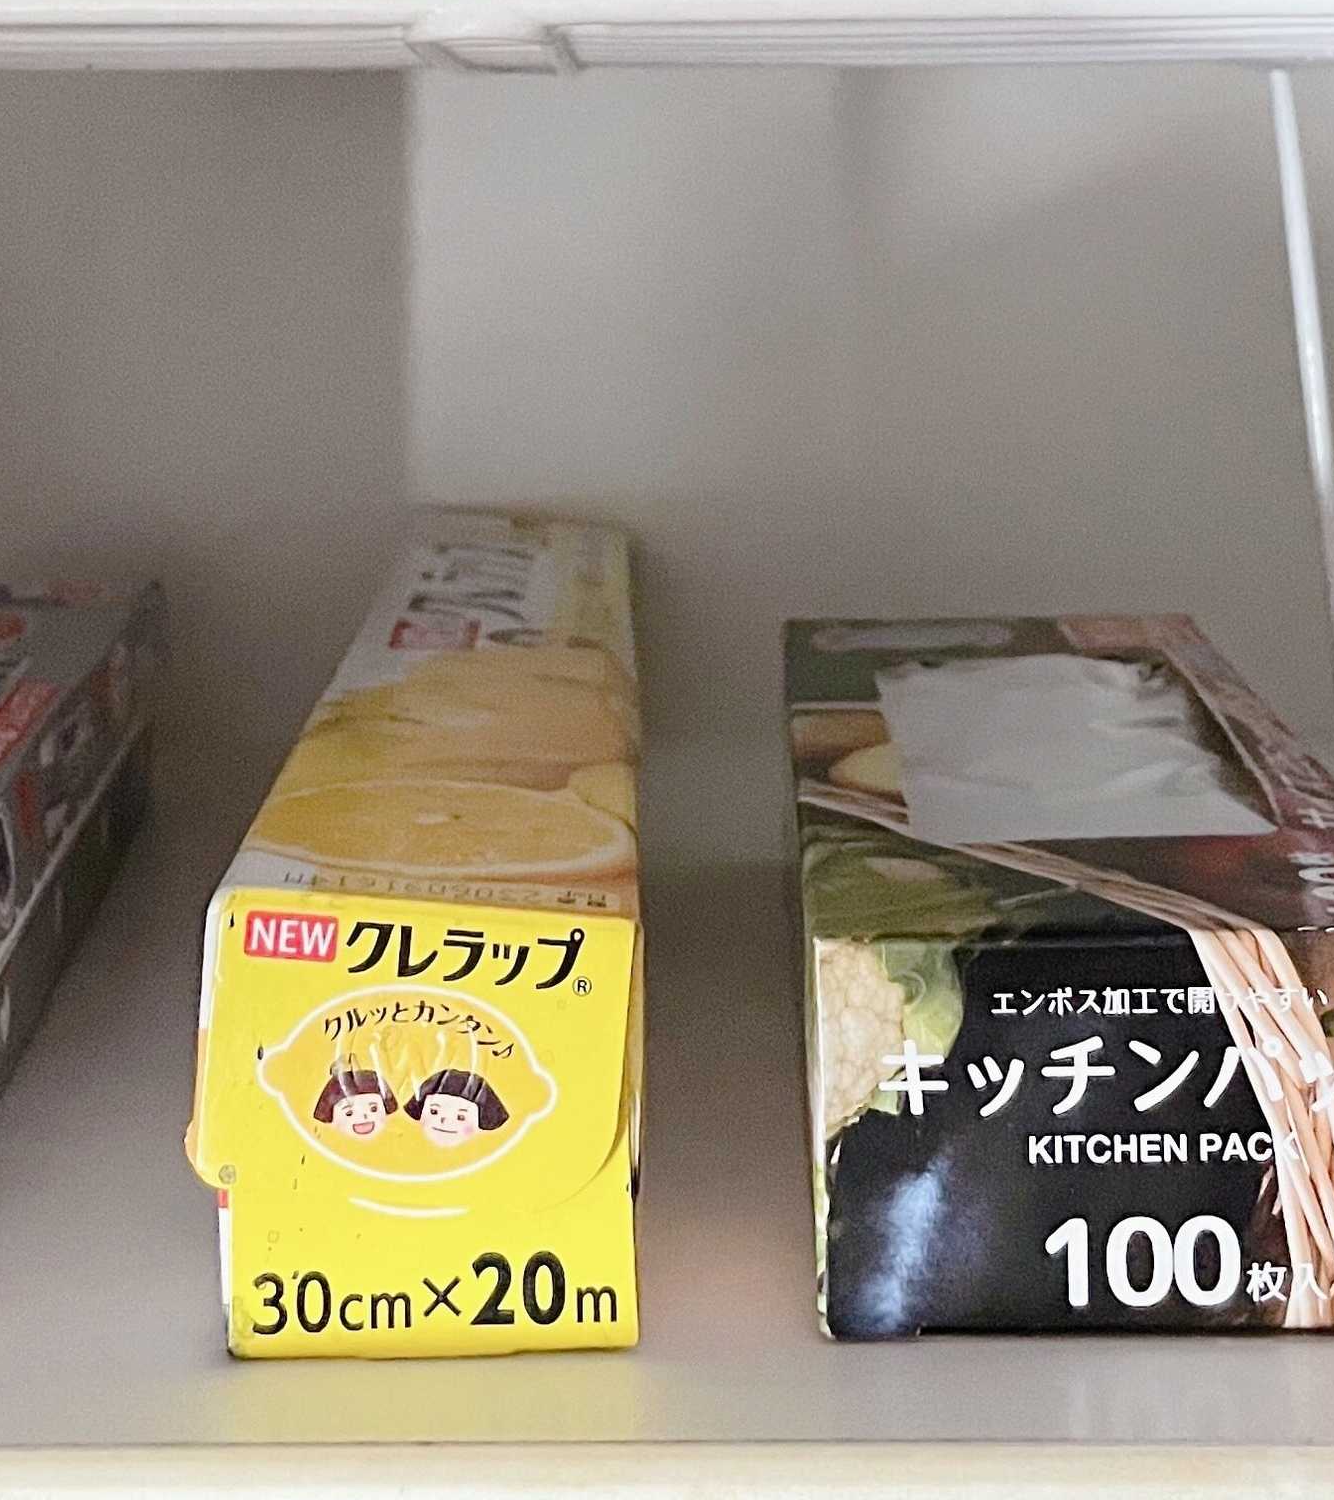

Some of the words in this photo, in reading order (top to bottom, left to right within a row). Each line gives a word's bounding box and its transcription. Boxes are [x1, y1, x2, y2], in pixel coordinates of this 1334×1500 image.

[250, 920, 335, 957] NEW
[990, 986, 1329, 1017] エンボス加工で開けやすい
[1028, 1134, 1189, 1165] KITCHEN
[1199, 1134, 1299, 1163] PACK
